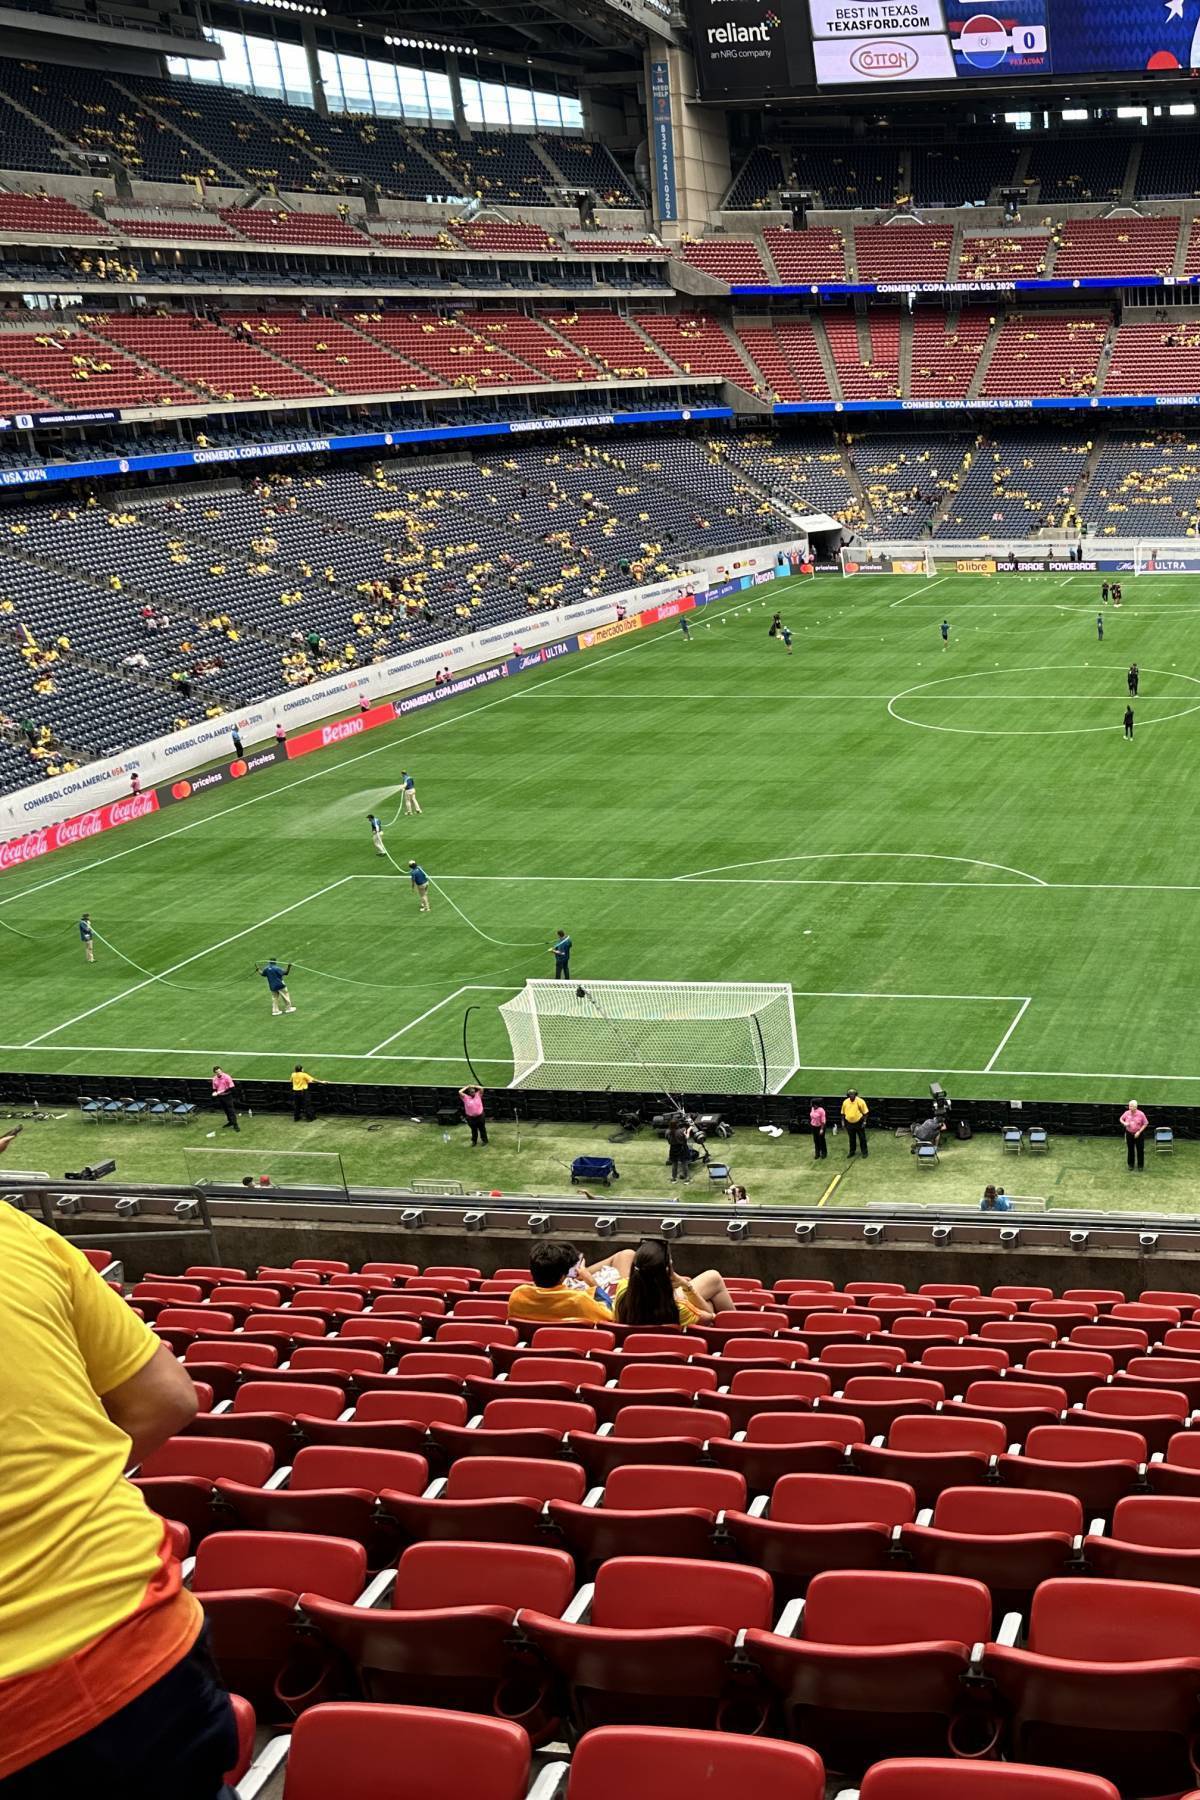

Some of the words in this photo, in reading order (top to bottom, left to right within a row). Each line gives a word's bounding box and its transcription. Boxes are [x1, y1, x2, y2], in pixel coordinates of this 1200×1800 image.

[836, 8, 864, 19] BEST
[868, 7, 878, 17] IN
[882, 5, 918, 16] TEXAS
[707, 22, 770, 43] reliant
[827, 17, 930, 31] TEXASFORD.COM
[1024, 32, 1035, 49] 0
[711, 51, 719, 59] an
[720, 50, 737, 58] NRG
[739, 49, 771, 58] company
[859, 51, 908, 69] COTTON
[876, 284, 922, 292] CONMEBOL
[922, 284, 946, 292] COPA
[946, 282, 980, 292] AMERICA
[981, 282, 996, 290] USA
[996, 282, 1016, 290] 2024
[902, 400, 944, 409] CONMEBOL
[945, 400, 966, 408] COPA
[966, 400, 998, 408] AMERICA
[1000, 400, 1014, 408] USA
[1156, 396, 1198, 404] CONMEBOL
[22, 416, 28, 426] 0
[194, 450, 240, 463] CONMEBOL
[240, 448, 263, 458] COPA
[262, 444, 297, 456] AMERICA
[296, 442, 311, 452] USA
[312, 440, 330, 450] 2024
[3, 472, 23, 483] USA
[22, 469, 47, 481] 2024
[966, 561, 988, 570] libre
[1049, 562, 1096, 570] POWERADE
[596, 626, 623, 640] mercado
[624, 618, 637, 632] libre
[480, 634, 503, 646] CONMEBOL
[546, 643, 568, 658] ULTRA
[388, 662, 414, 676] CONMEBOL
[413, 658, 425, 668] COPA
[425, 652, 444, 665] AMERICA
[283, 696, 312, 712] CONMEBOL
[312, 690, 326, 702] COPA
[326, 684, 348, 697] AMERICA
[400, 692, 436, 711] CONMEBOL
[435, 685, 452, 700] COPA
[451, 678, 476, 694] AMERICA
[164, 739, 198, 756] CONMEBOL
[198, 732, 214, 744] COPA
[238, 718, 250, 728] USA
[322, 718, 364, 745] Betano
[248, 753, 275, 770] priceless
[24, 791, 62, 811] CONMEBOL
[62, 782, 82, 796] COPA
[82, 772, 112, 788] AMERICA
[112, 767, 124, 777] USA
[124, 760, 140, 772] 2024
[192, 773, 222, 791] priceless
